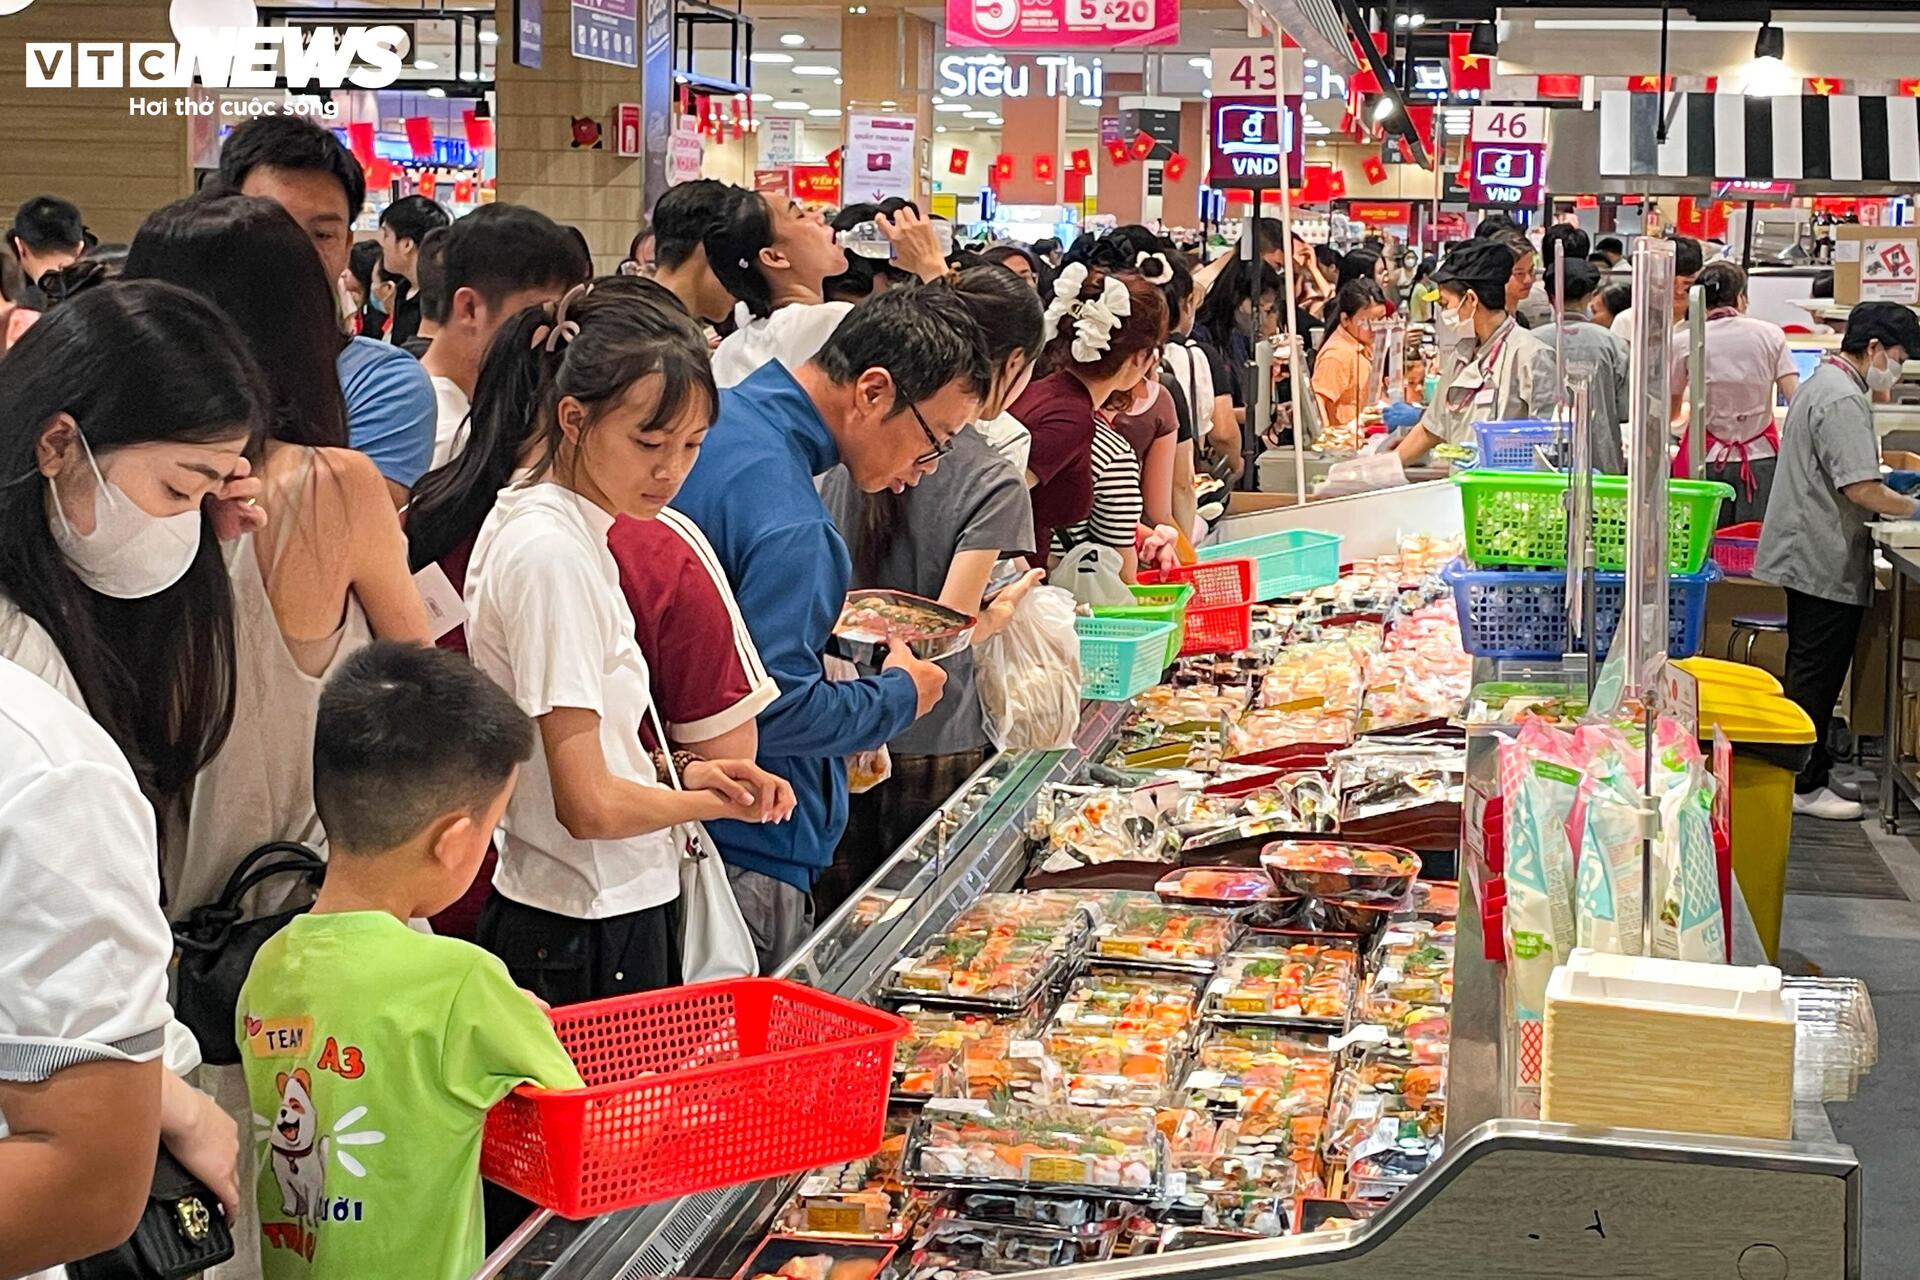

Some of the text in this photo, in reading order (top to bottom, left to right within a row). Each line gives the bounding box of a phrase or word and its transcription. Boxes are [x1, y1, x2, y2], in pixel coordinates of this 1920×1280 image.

[1229, 55, 1276, 90] 43
[1487, 112, 1527, 138] 46
[1232, 158, 1279, 175] VND
[1486, 187, 1521, 202] VND
[266, 1028, 304, 1050] TEAM
[317, 1036, 367, 1079] A3
